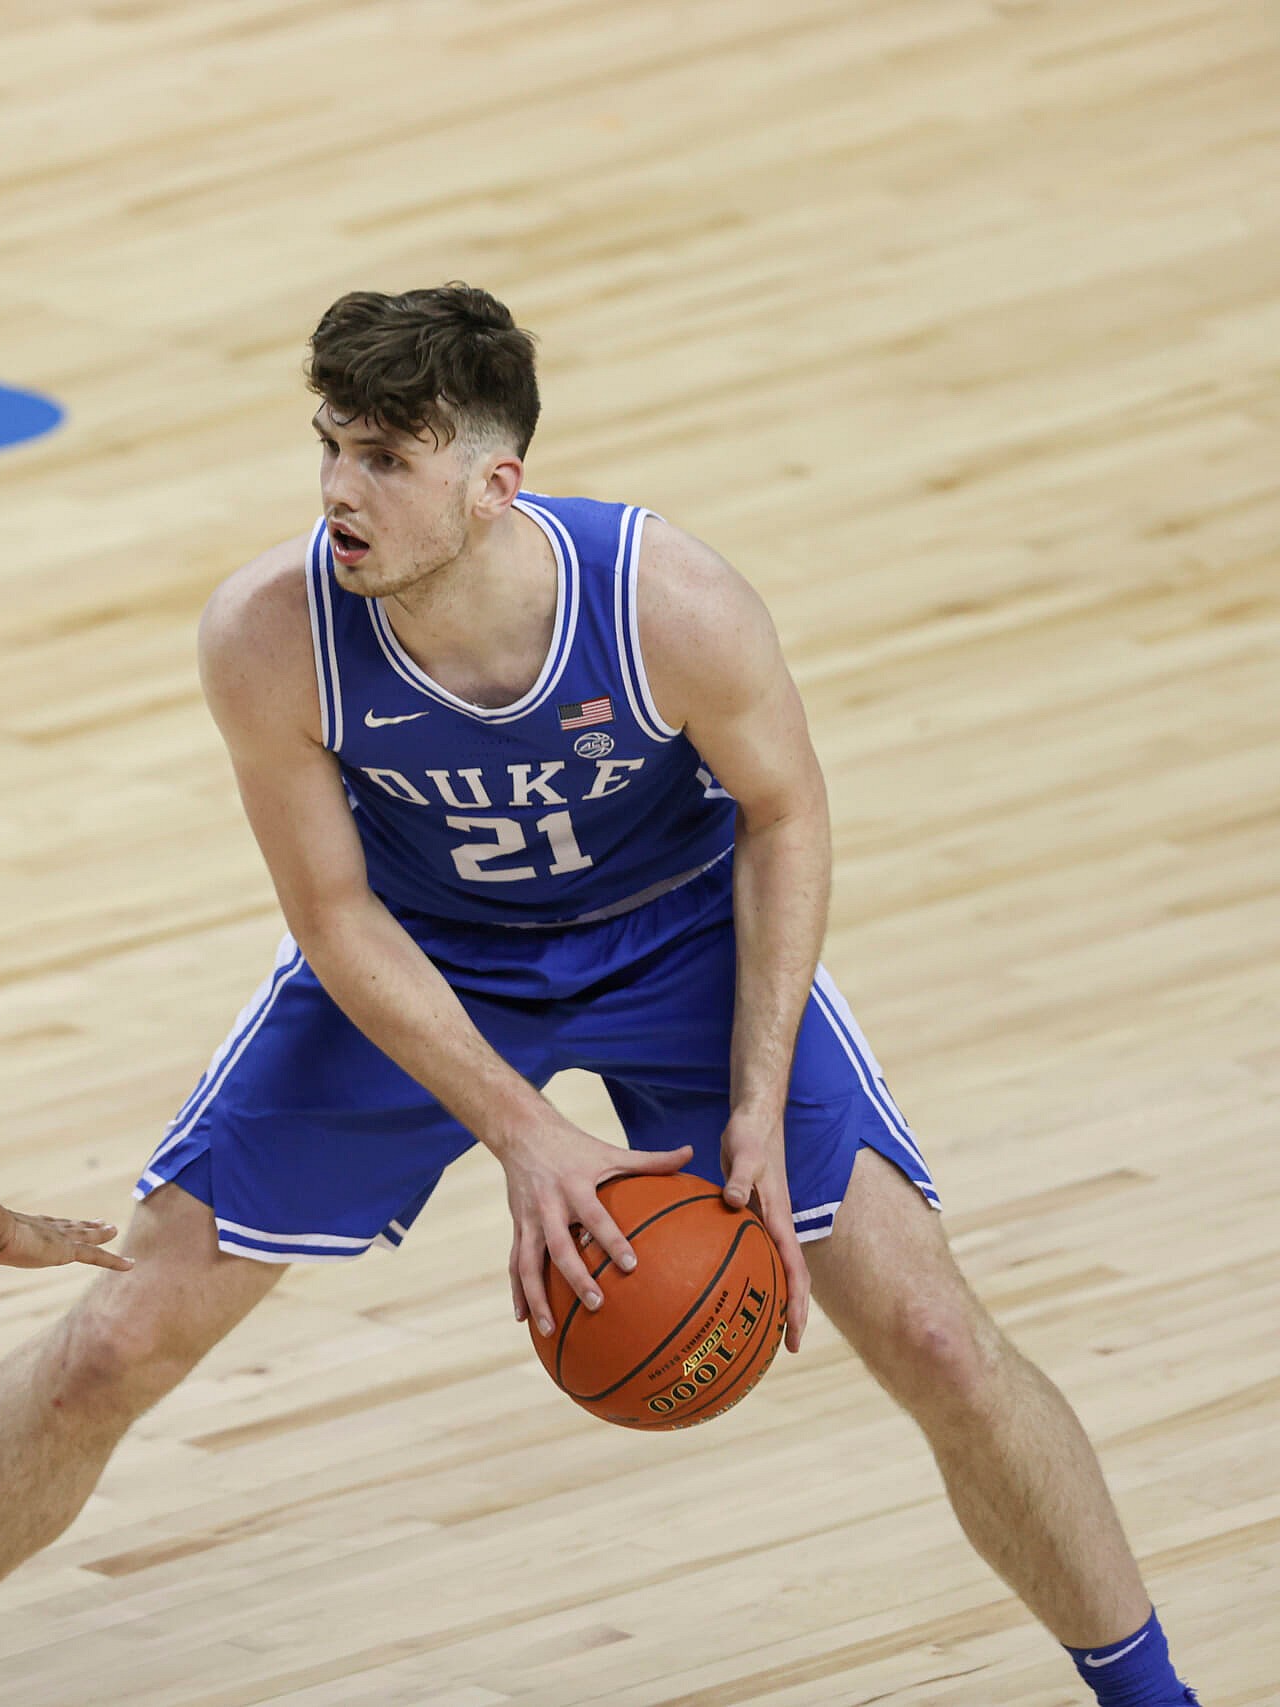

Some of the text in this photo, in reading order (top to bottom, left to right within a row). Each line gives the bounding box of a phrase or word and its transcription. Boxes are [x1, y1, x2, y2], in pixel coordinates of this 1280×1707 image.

[359, 758, 645, 809] DUKE
[445, 811, 593, 882] 21
[647, 1285, 766, 1413] TF-1000
[681, 1319, 728, 1377] LEGACY
